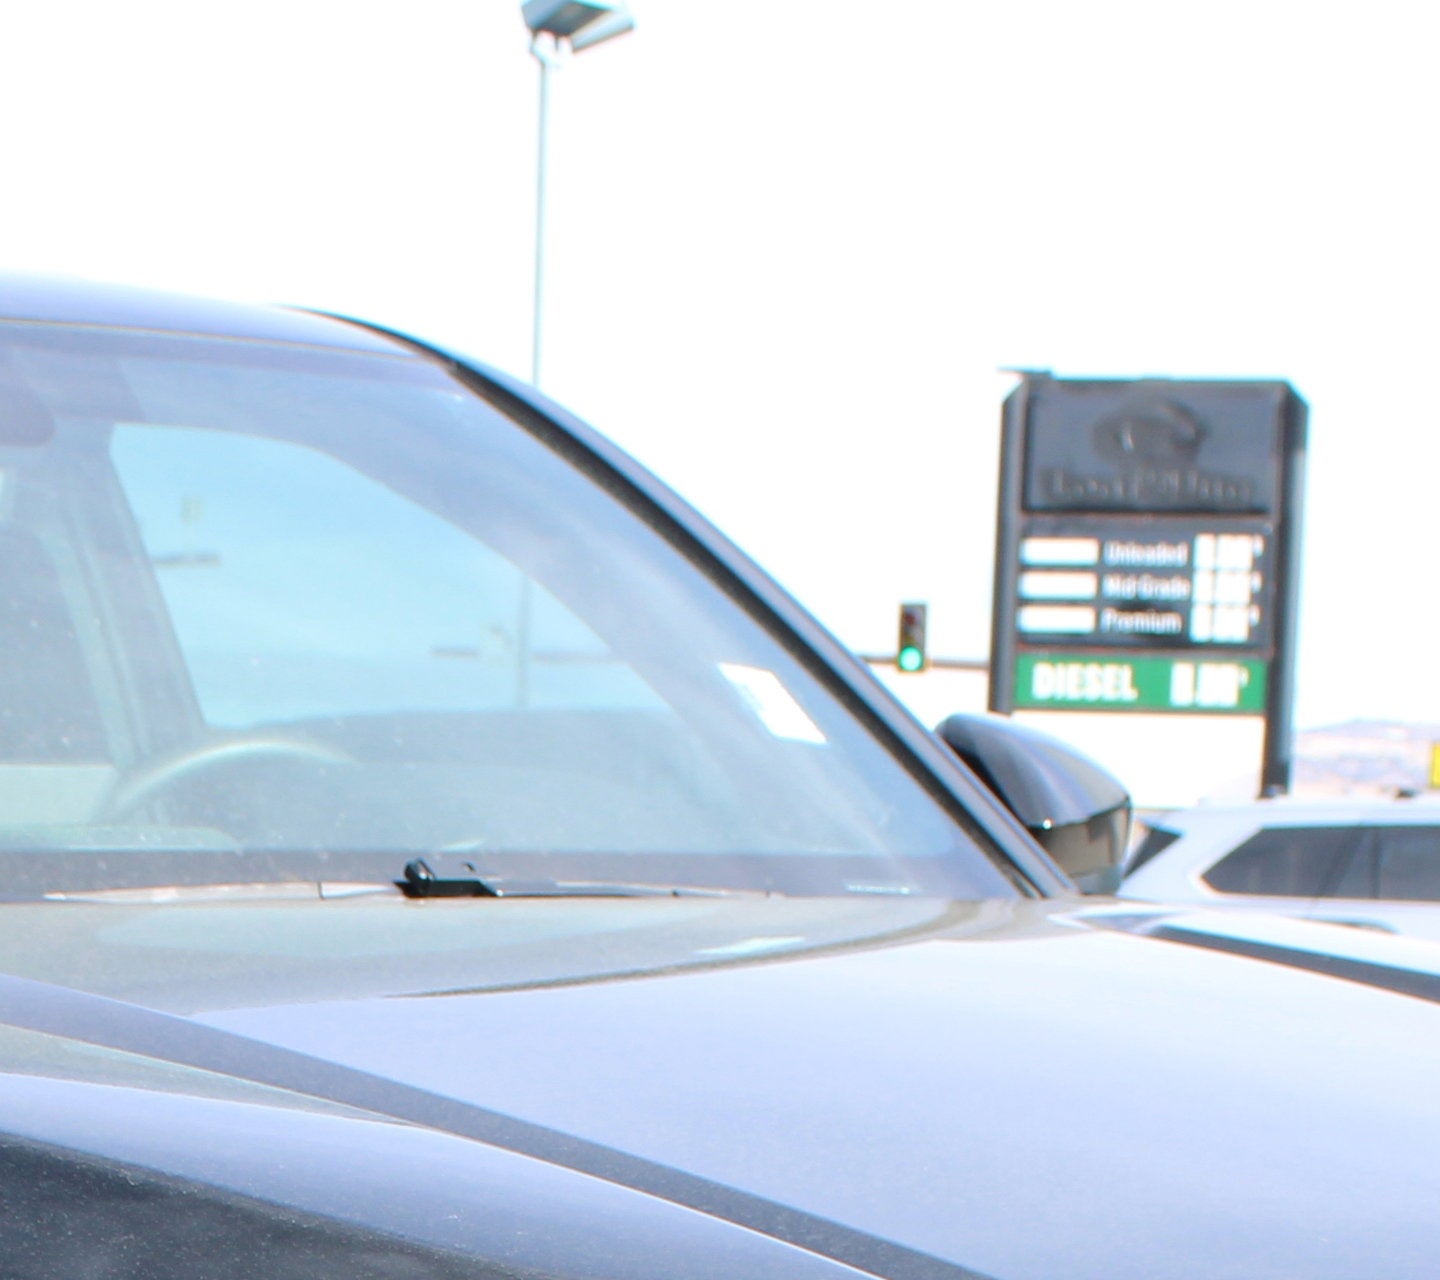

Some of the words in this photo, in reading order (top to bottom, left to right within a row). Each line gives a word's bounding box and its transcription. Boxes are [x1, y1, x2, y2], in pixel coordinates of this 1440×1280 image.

[1103, 541, 1188, 567] Unleaded
[1100, 607, 1182, 634] Premium
[1031, 662, 1139, 701] DIESEL
